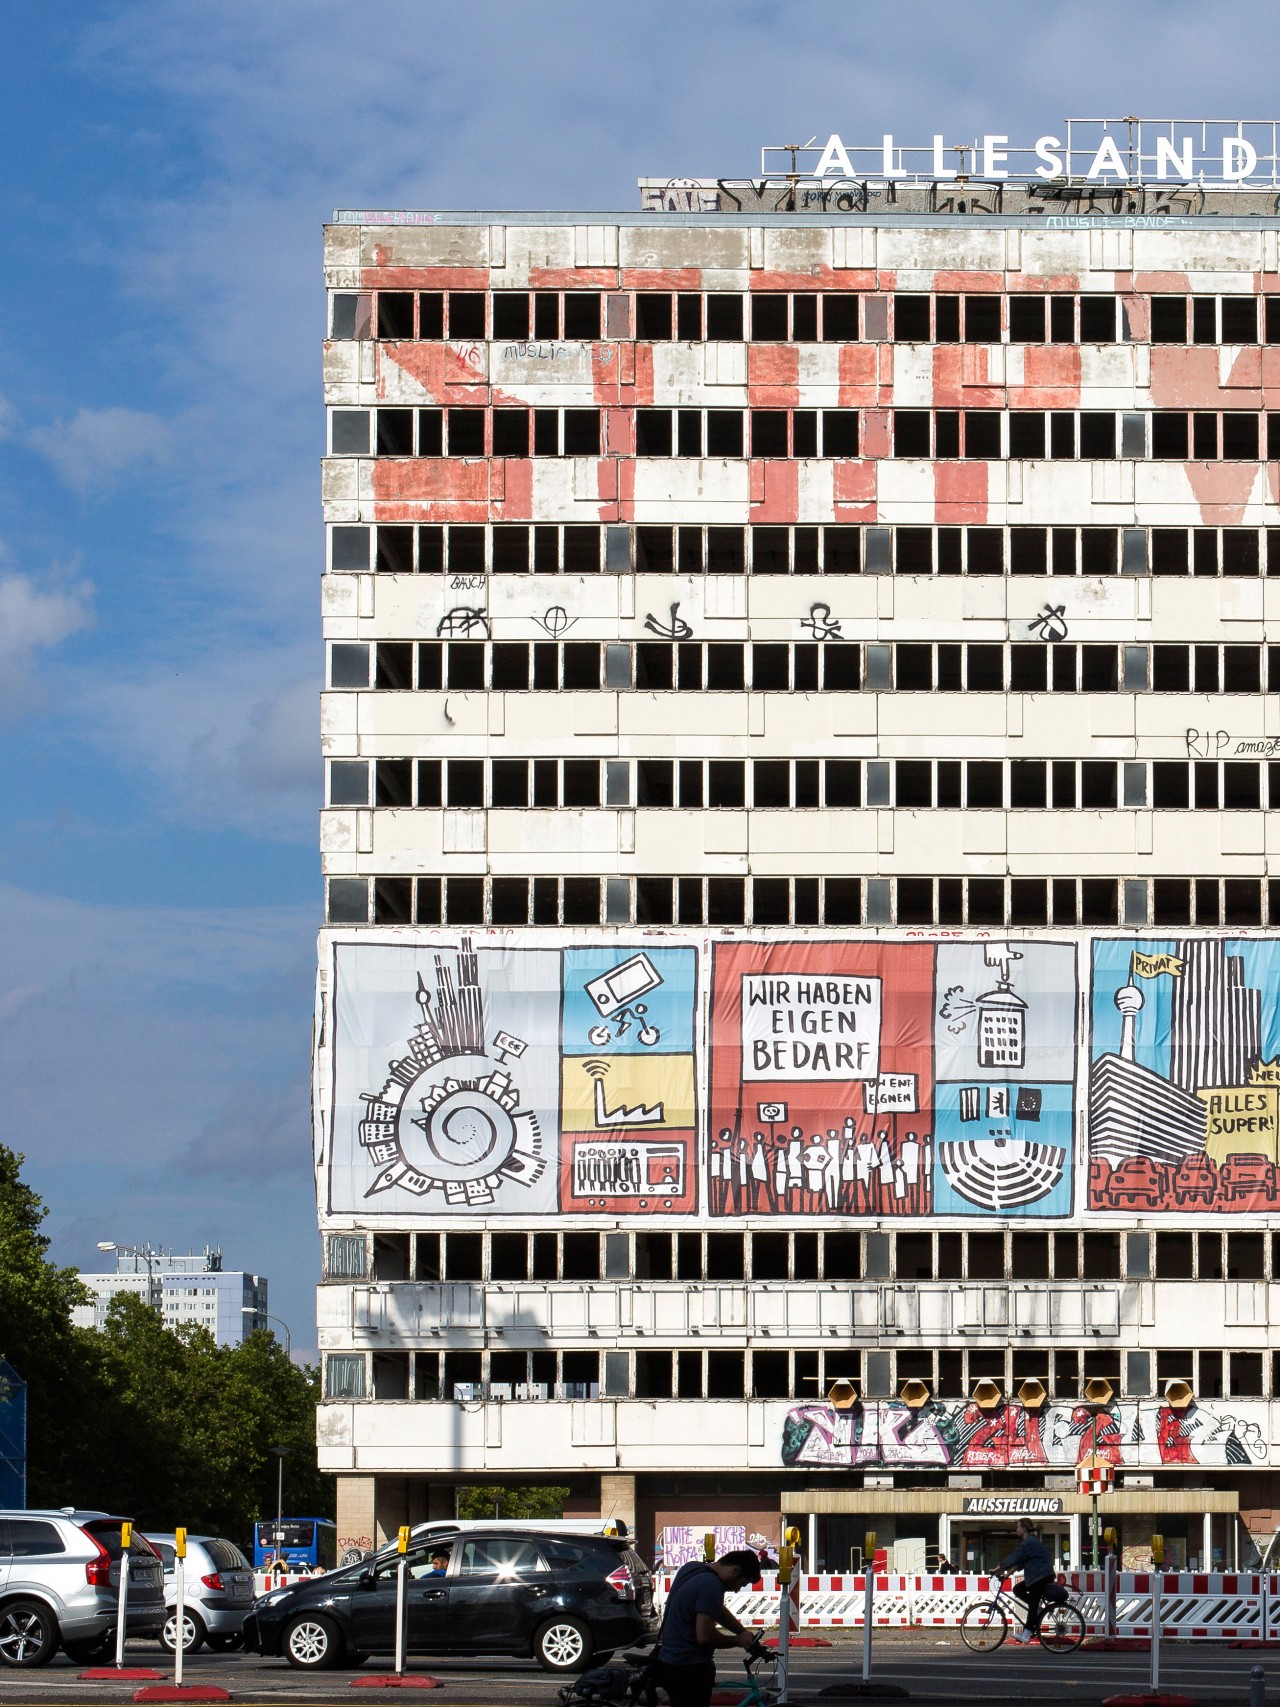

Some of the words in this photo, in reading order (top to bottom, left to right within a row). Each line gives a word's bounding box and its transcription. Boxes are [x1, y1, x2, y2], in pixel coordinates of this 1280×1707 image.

[1186, 728, 1231, 758] RIP
[1135, 956, 1173, 974] PRIVAT
[749, 980, 791, 1006] WIR
[797, 980, 872, 1006] HABEN
[771, 1009, 857, 1035] EIGEN
[752, 1039, 871, 1072] BEDARF
[1209, 1094, 1267, 1115] ALLES
[1210, 1115, 1275, 1134] SUPER!
[966, 1497, 1060, 1513] AUSSTELLUNG
